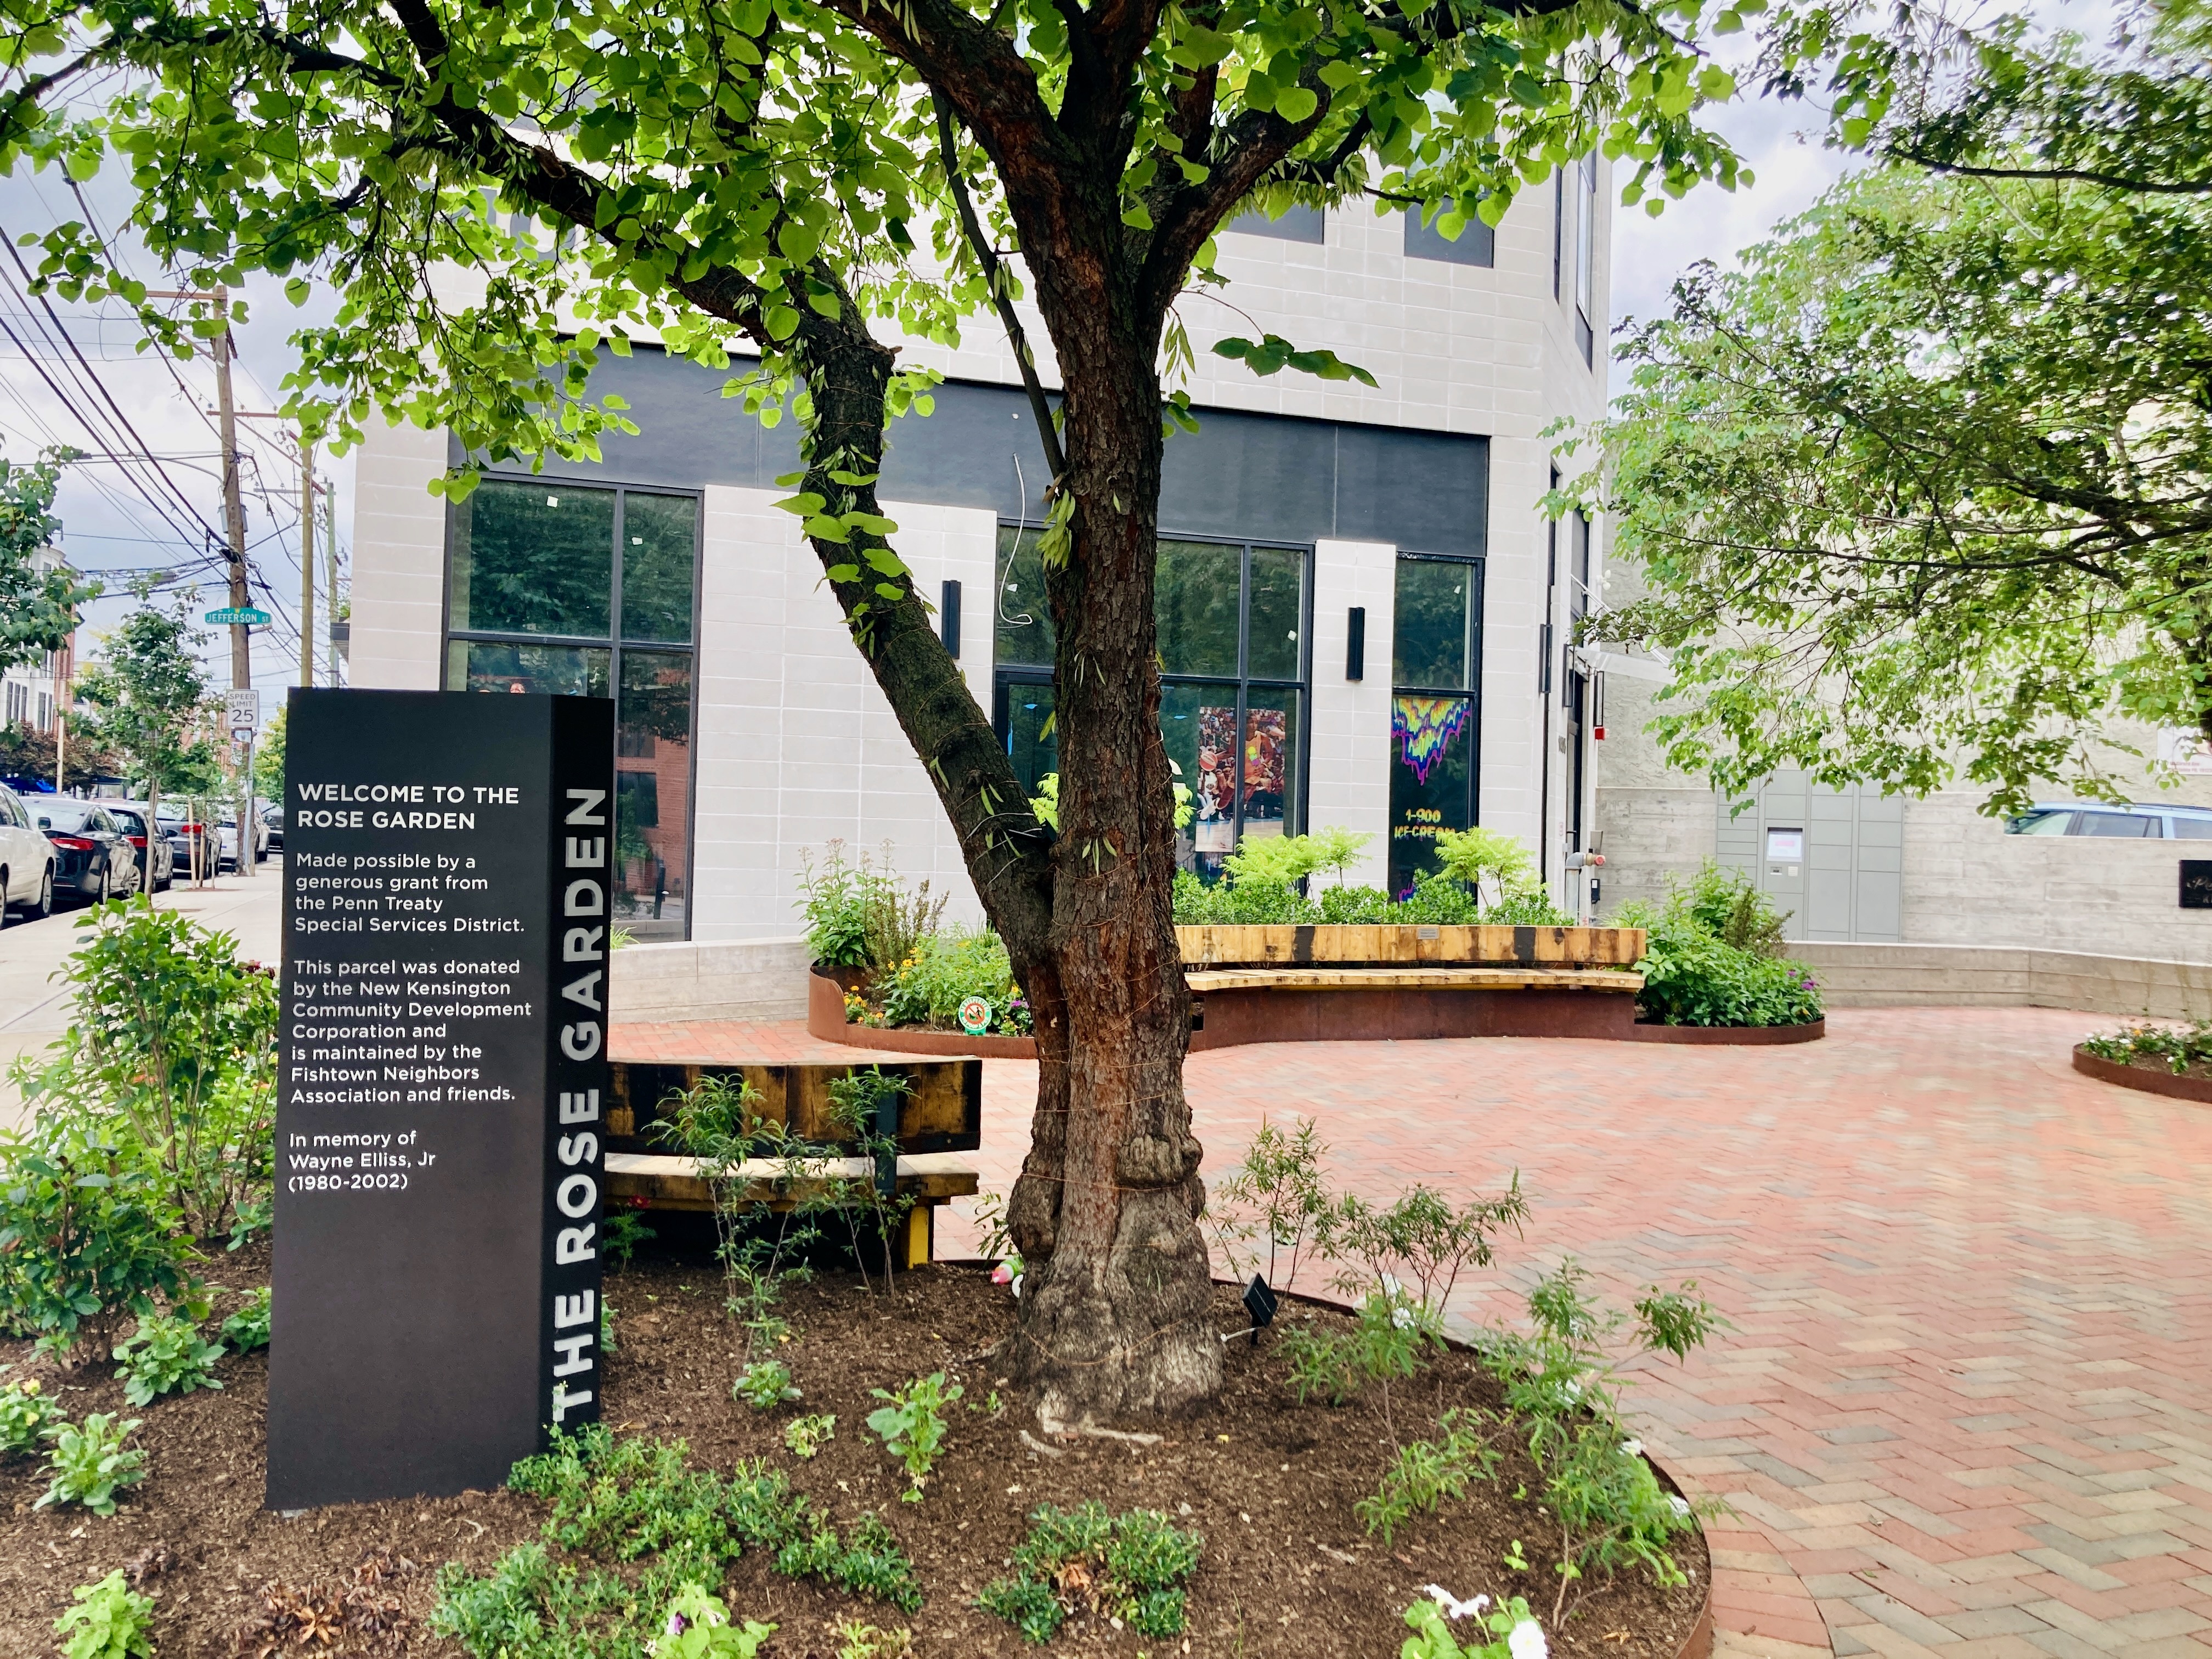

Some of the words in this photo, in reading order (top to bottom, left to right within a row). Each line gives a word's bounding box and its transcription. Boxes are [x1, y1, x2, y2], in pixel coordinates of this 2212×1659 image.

[206, 613, 257, 623] JEFFERSON
[232, 709, 253, 722] 25
[298, 783, 424, 803] WELCOME
[432, 786, 465, 803] TO
[472, 787, 519, 804] THE
[298, 810, 364, 828] ROSE
[372, 811, 475, 830] GARDEN
[1406, 808, 1441, 823] 1-900
[297, 853, 347, 867] Made
[354, 853, 431, 870] possible
[437, 854, 460, 871] by
[465, 857, 476, 868] a
[296, 877, 383, 891] generous
[390, 876, 439, 892] grant
[445, 875, 488, 890] from
[295, 895, 325, 910] the
[332, 896, 378, 910] Penn
[385, 896, 443, 913] Treaty
[295, 917, 363, 934] Special
[369, 917, 447, 932] Services
[454, 917, 524, 932] District.
[560, 788, 606, 1062] GARDEN
[294, 960, 332, 974] This
[338, 960, 396, 977] parcel
[402, 963, 437, 974] was
[443, 959, 520, 974] donated
[294, 981, 317, 998] by
[322, 981, 353, 996] the
[359, 981, 400, 996] New
[407, 980, 511, 998] Kensington
[292, 1002, 402, 1019] Community
[408, 1002, 532, 1019] Development
[292, 1024, 405, 1042] Corporation
[412, 1023, 446, 1038] and
[292, 1046, 306, 1060] is
[313, 1044, 417, 1060] maintained
[424, 1044, 446, 1062] by
[452, 1044, 482, 1059] the
[291, 1066, 377, 1082] Fishtown
[383, 1065, 479, 1083] Neighbors
[290, 1087, 400, 1104] Association
[407, 1086, 441, 1103] and
[447, 1085, 515, 1102] friends.
[290, 1133, 307, 1149] In
[313, 1133, 391, 1148] memory
[397, 1130, 417, 1145] of
[288, 1153, 354, 1172] Wayne
[360, 1152, 411, 1169] Elliss,
[417, 1151, 436, 1166] Jr
[288, 1173, 409, 1193] (1980-2002)
[556, 1088, 600, 1266] ROSE
[552, 1289, 595, 1422] THE
